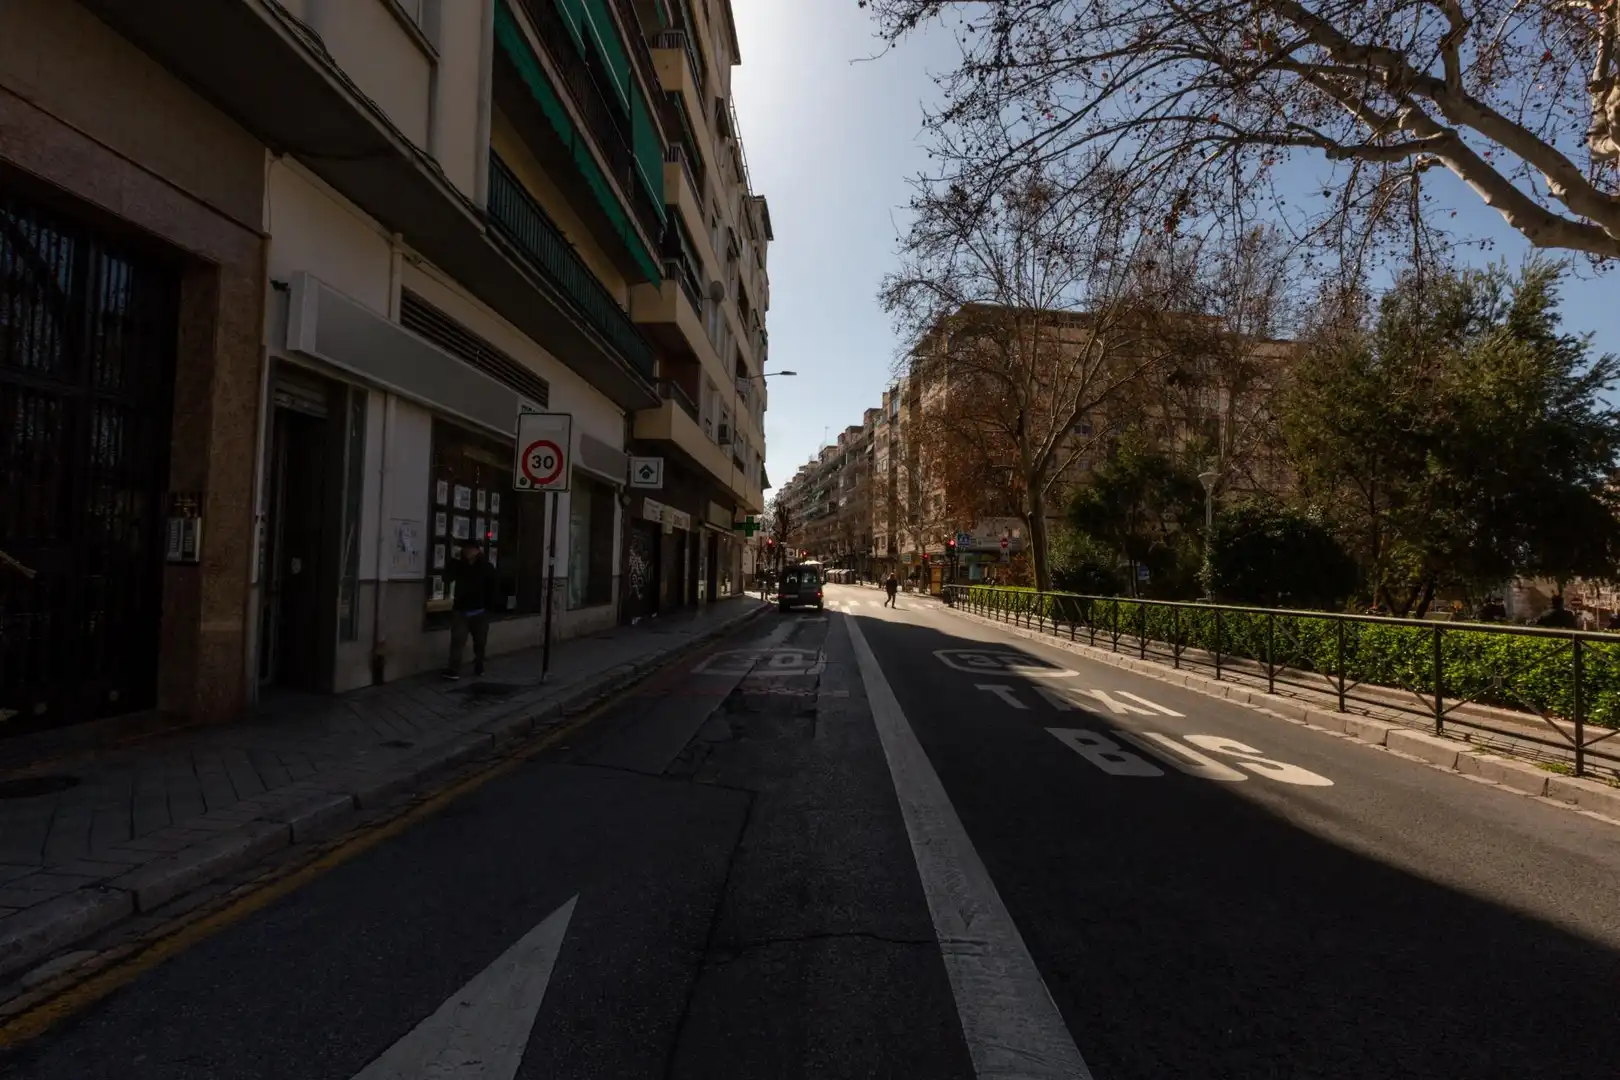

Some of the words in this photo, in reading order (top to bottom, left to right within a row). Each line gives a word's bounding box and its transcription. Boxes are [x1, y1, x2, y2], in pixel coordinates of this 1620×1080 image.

[531, 455, 554, 469] 30
[957, 653, 1048, 673] 30
[975, 683, 1186, 717] TAXI
[1044, 727, 1335, 786] BUS
